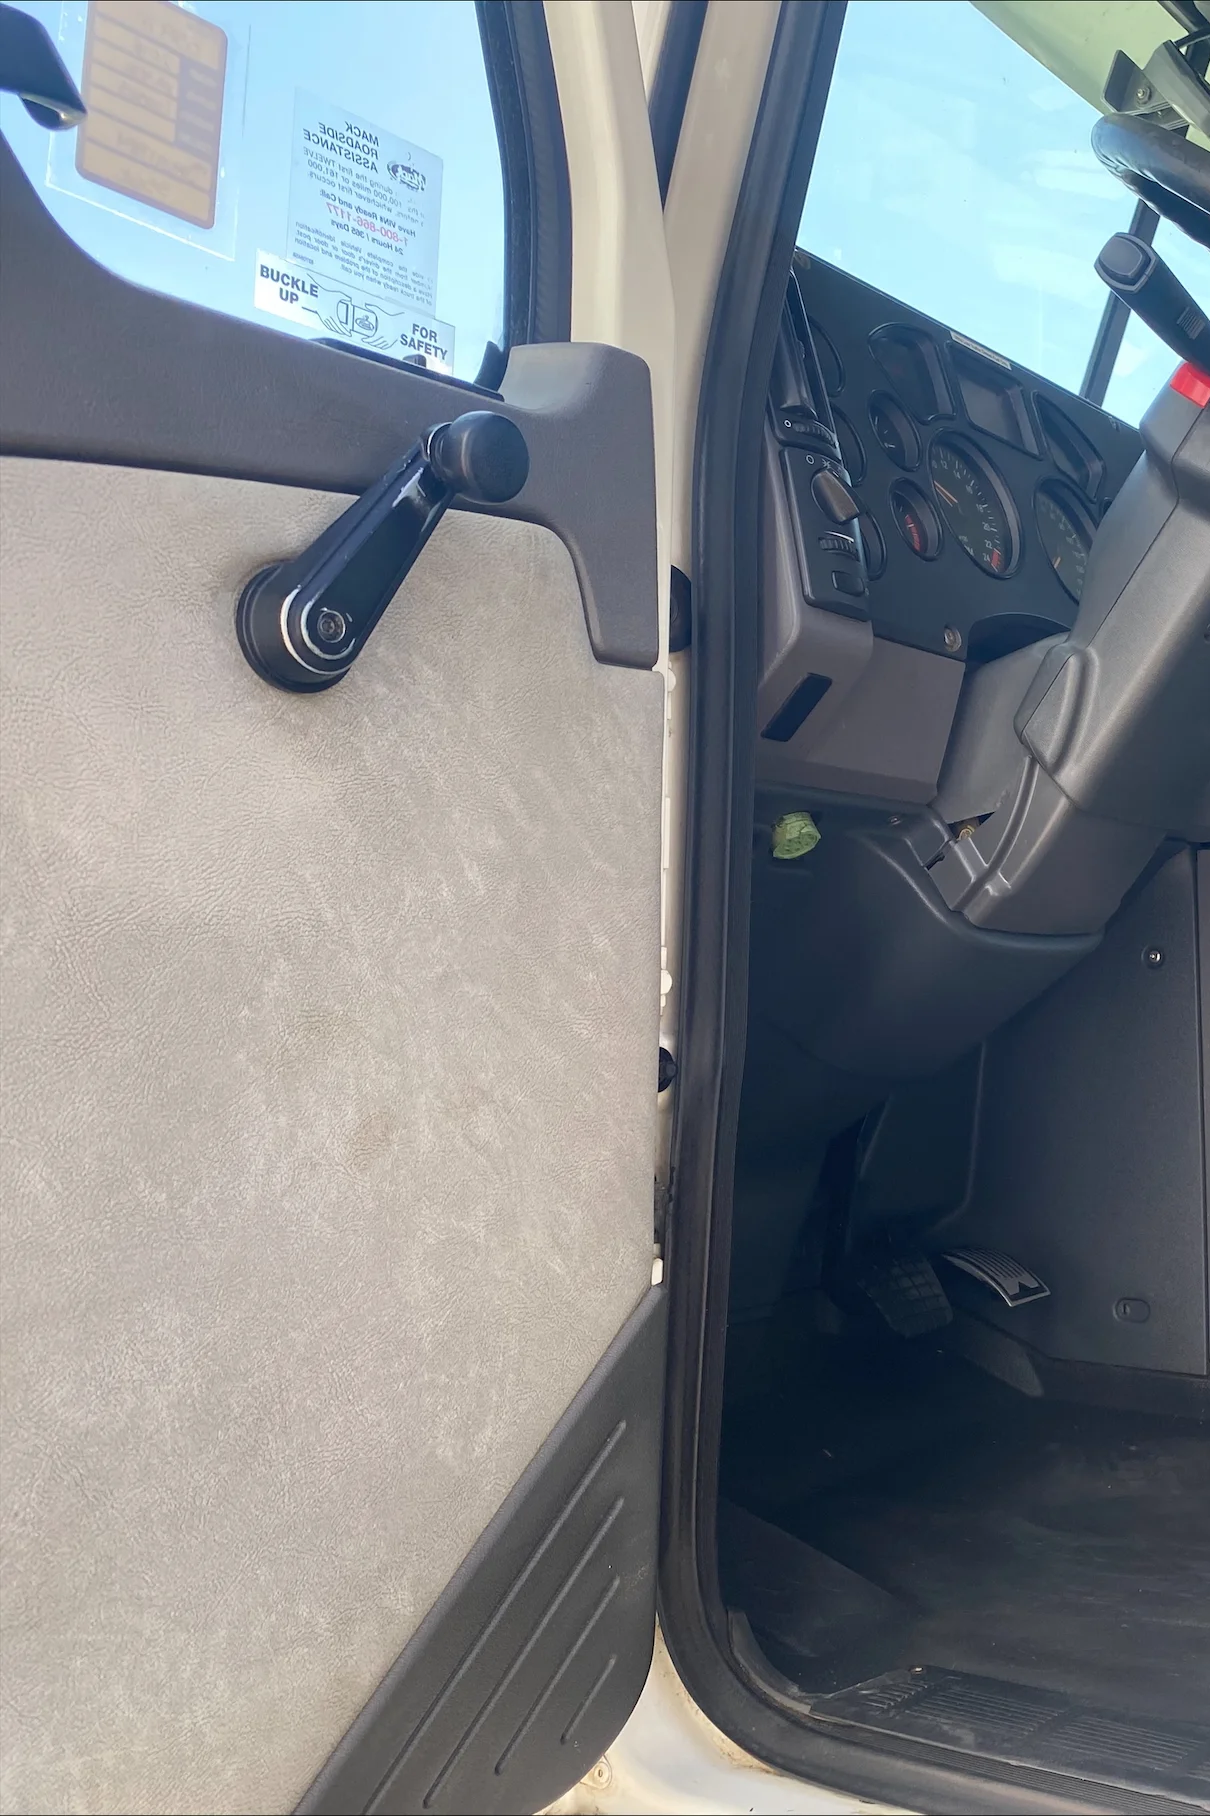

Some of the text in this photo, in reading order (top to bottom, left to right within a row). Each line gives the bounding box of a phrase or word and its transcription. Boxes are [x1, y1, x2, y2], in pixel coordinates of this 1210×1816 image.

[259, 263, 320, 299] BUCKLE
[278, 287, 300, 305] UP
[412, 323, 438, 344] FOR
[400, 334, 448, 361] SAFETY
